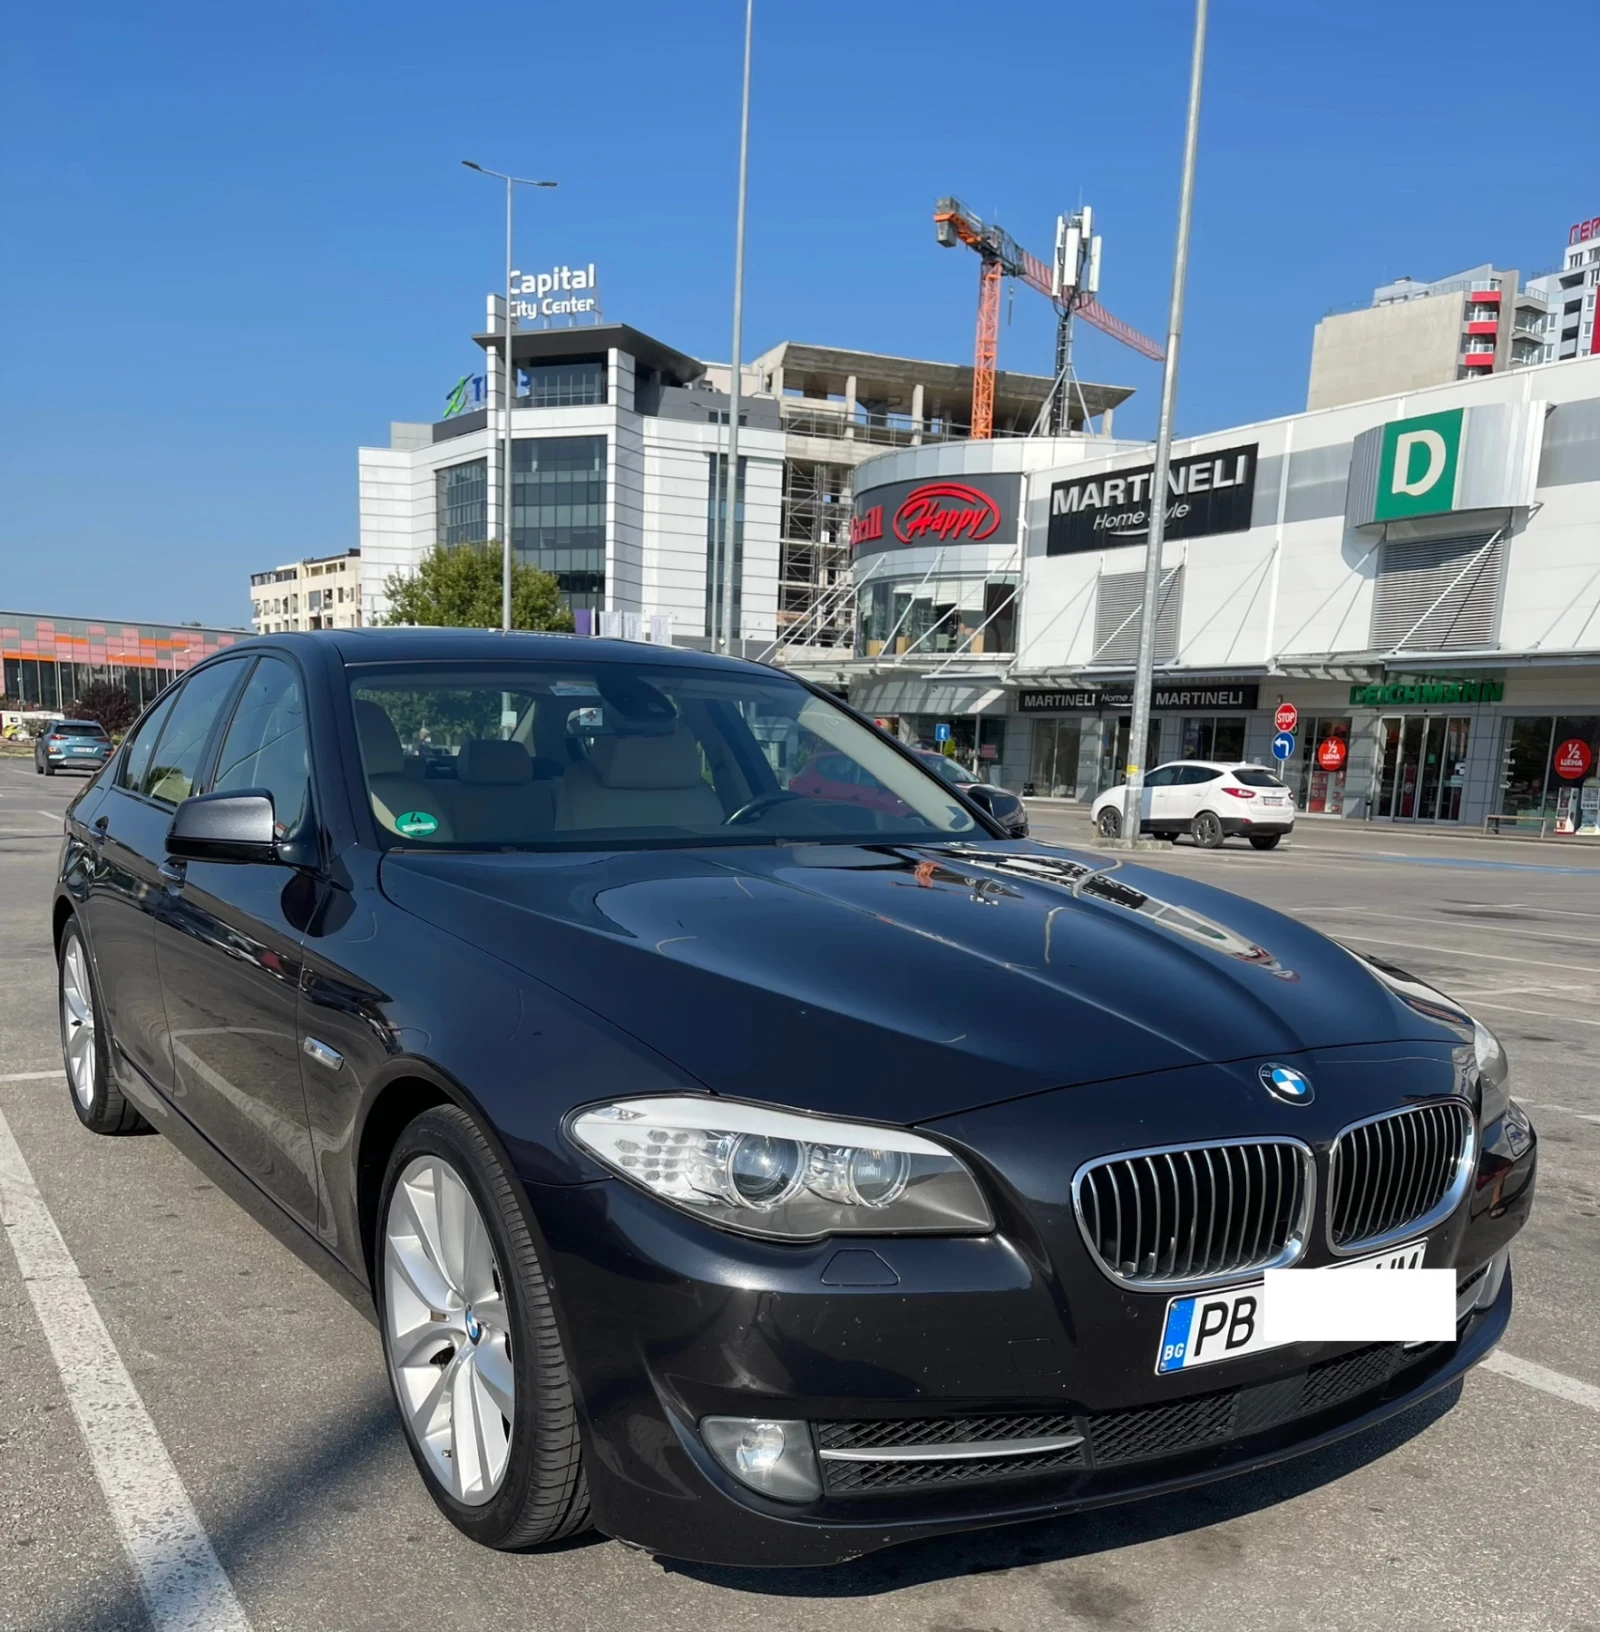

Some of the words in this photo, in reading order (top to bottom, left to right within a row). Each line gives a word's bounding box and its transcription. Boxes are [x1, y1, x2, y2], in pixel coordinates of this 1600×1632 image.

[509, 263, 595, 298] Capital
[542, 296, 594, 314] Center
[1391, 429, 1446, 496] D
[850, 505, 883, 545] Grill
[903, 497, 990, 541] Happy
[1093, 510, 1144, 530] Home
[1024, 693, 1095, 708] MARTINELI
[1100, 693, 1128, 702] Home
[1156, 691, 1243, 706] MARTINELI
[1349, 682, 1504, 705] DEICHMANN
[1277, 712, 1295, 723] STOP
[1560, 758, 1583, 766] ЦЕНА
[1193, 1296, 1257, 1357] PB
[1163, 1343, 1185, 1361] BG
